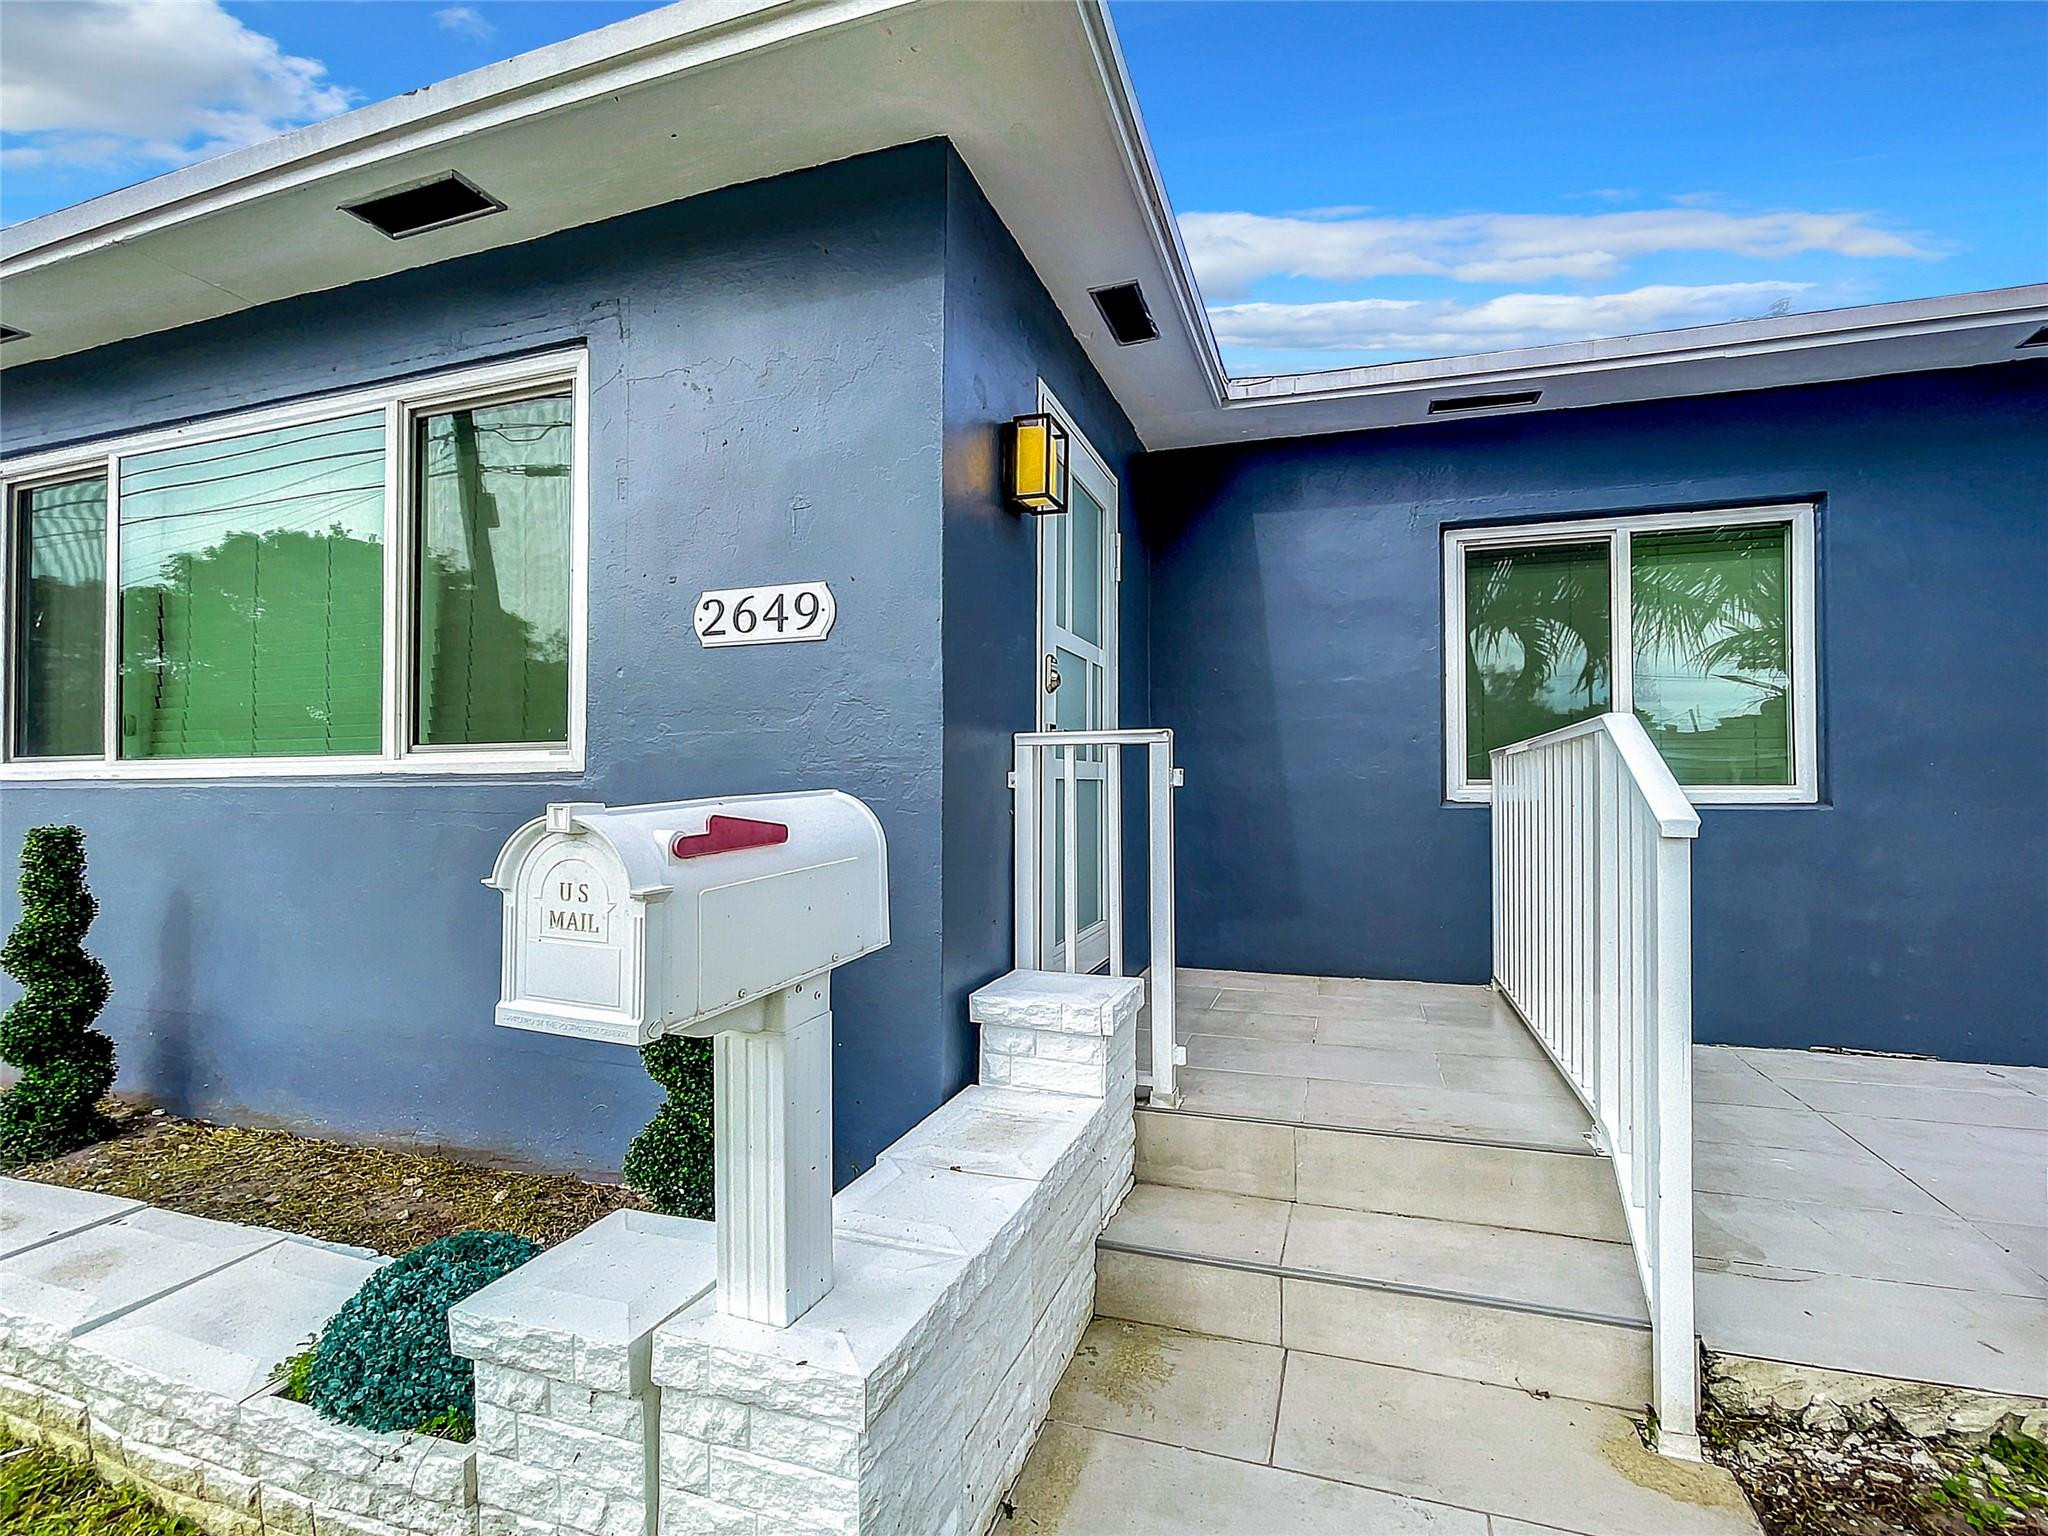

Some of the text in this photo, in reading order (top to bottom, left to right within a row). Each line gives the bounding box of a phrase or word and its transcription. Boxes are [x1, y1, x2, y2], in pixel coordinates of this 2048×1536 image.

[702, 591, 819, 636] 2649
[560, 882, 589, 903] US
[549, 910, 600, 933] MAIL
